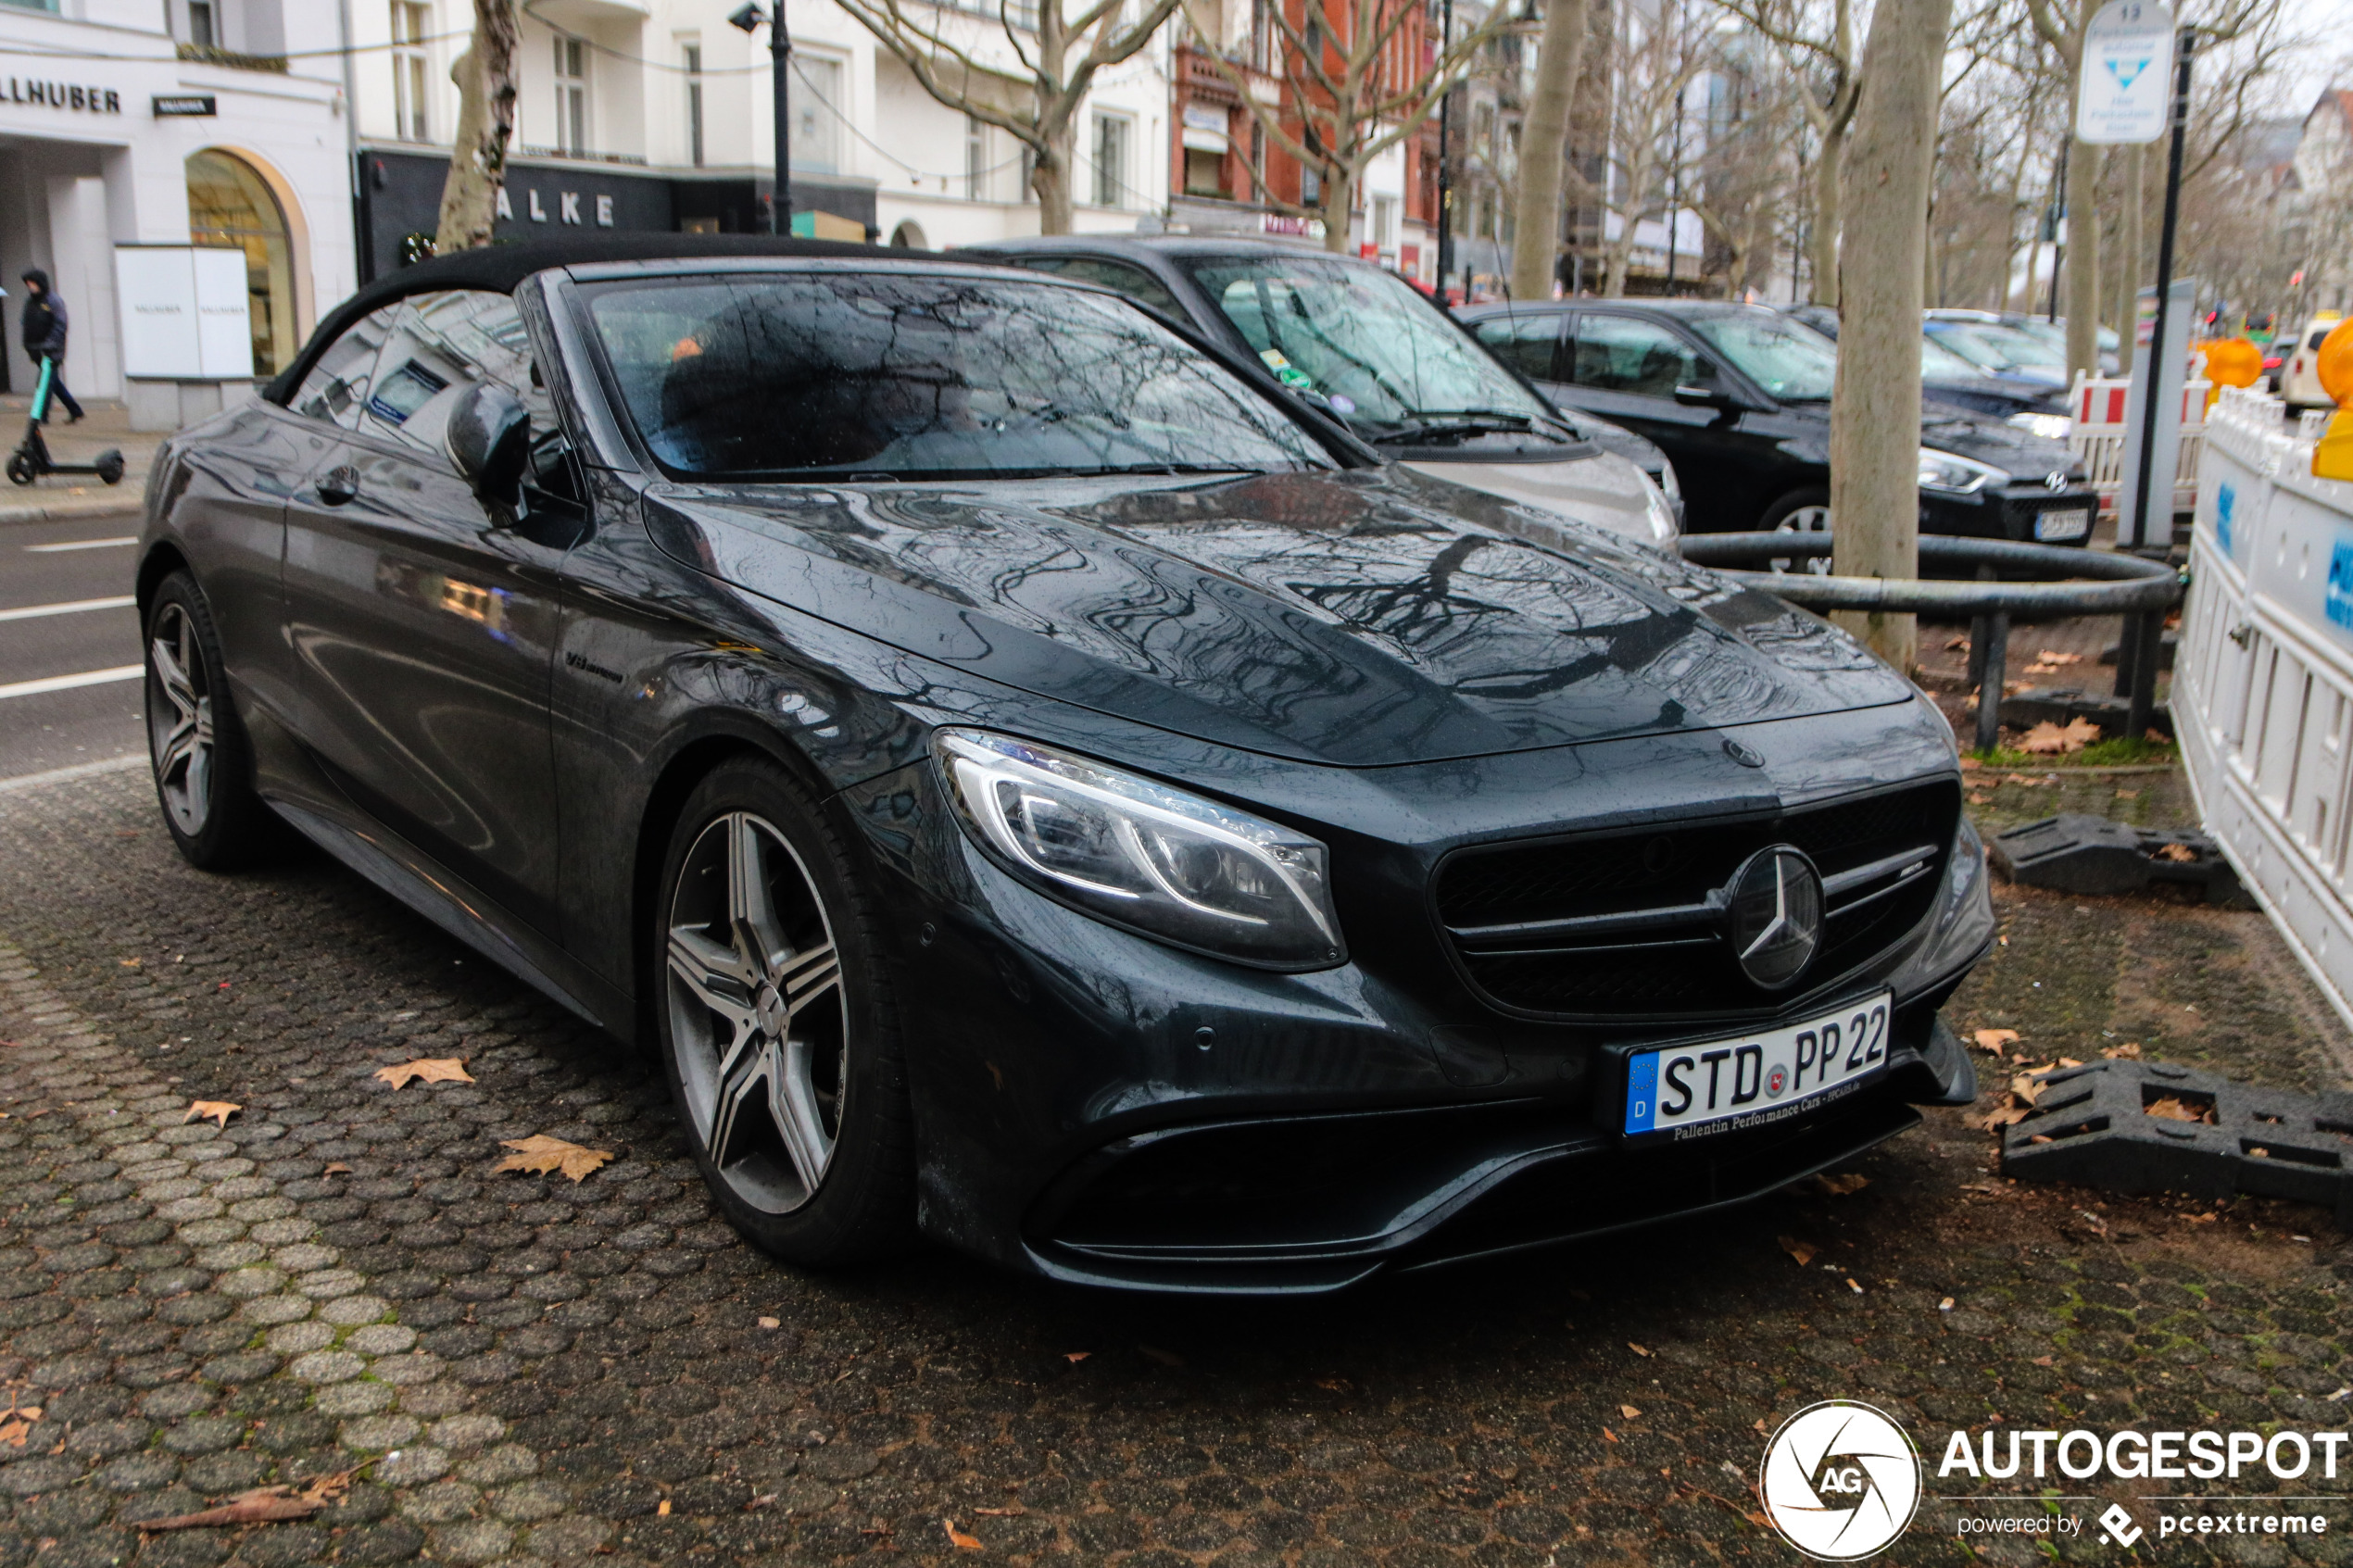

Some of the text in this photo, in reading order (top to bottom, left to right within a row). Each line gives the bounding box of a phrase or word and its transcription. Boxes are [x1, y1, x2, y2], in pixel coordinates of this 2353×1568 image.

[497, 186, 613, 227] ALKE
[1661, 1005, 1886, 1115] STD PP 22
[1634, 1101, 1646, 1118] D
[1673, 1120, 1729, 1141] Pallentin
[1801, 1096, 1821, 1111] Cars
